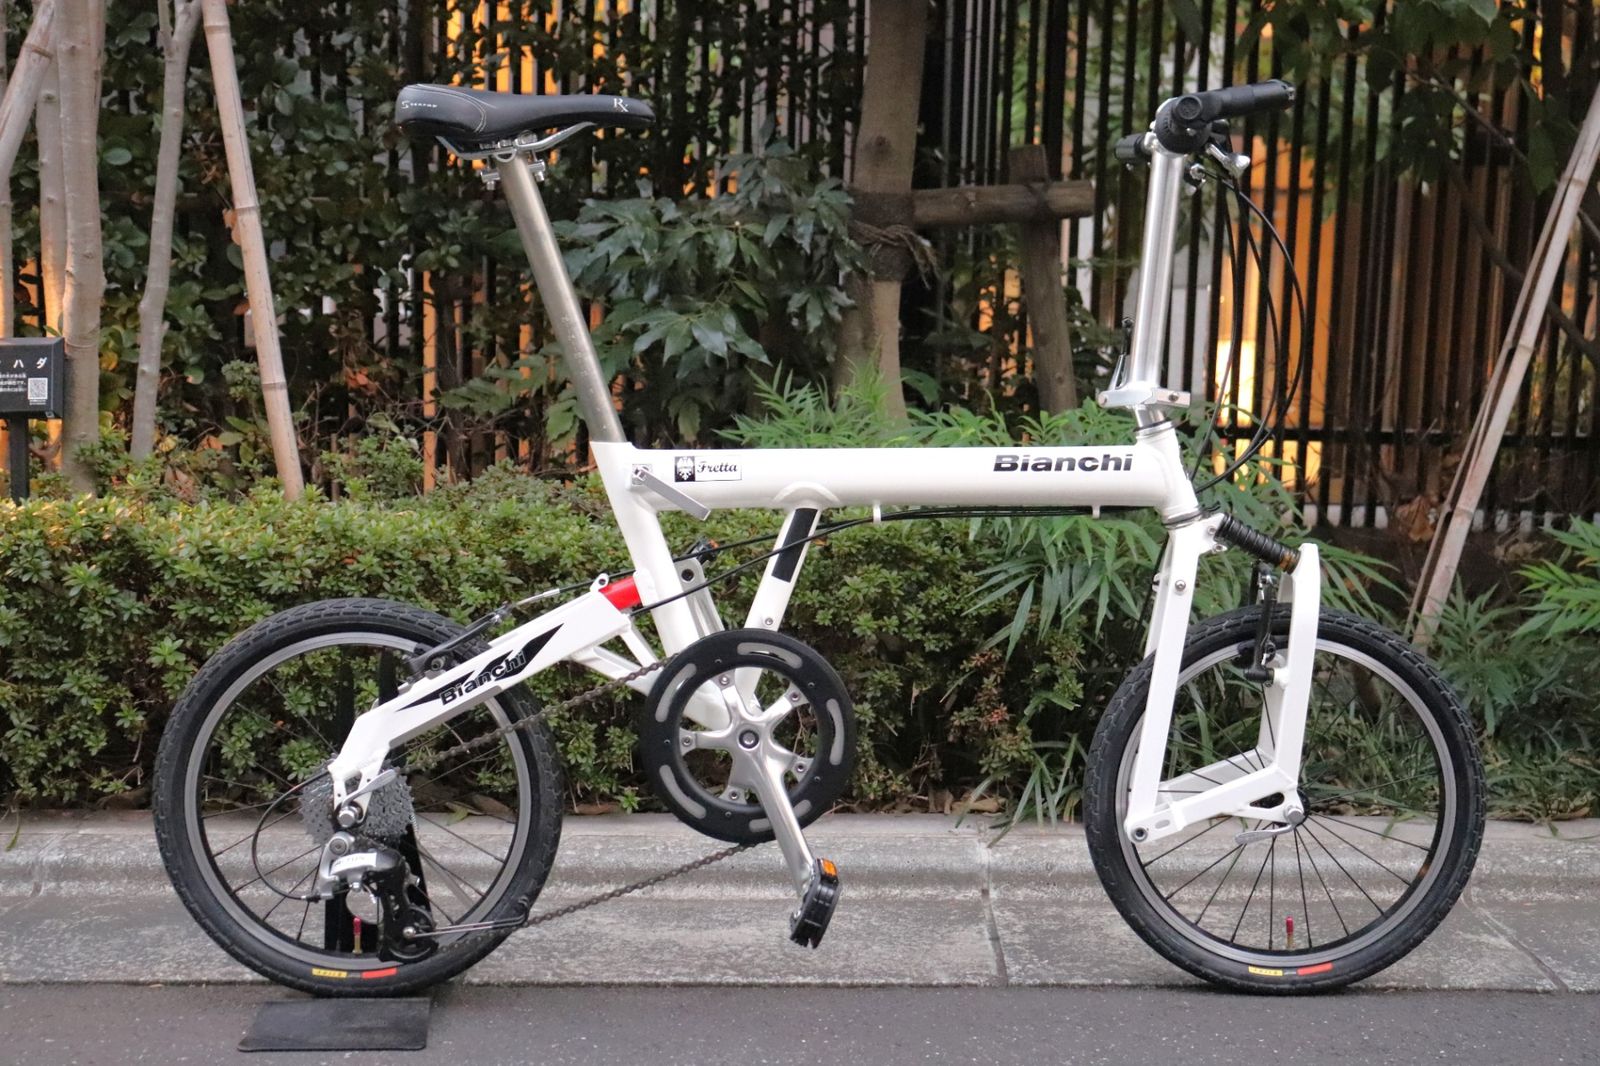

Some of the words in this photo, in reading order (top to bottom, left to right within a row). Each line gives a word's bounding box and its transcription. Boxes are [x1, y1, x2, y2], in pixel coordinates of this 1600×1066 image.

[0, 356, 48, 369] ハダ
[697, 460, 738, 473] Fretta
[993, 454, 1133, 472] Bianchi
[440, 649, 527, 706] Bianchi
